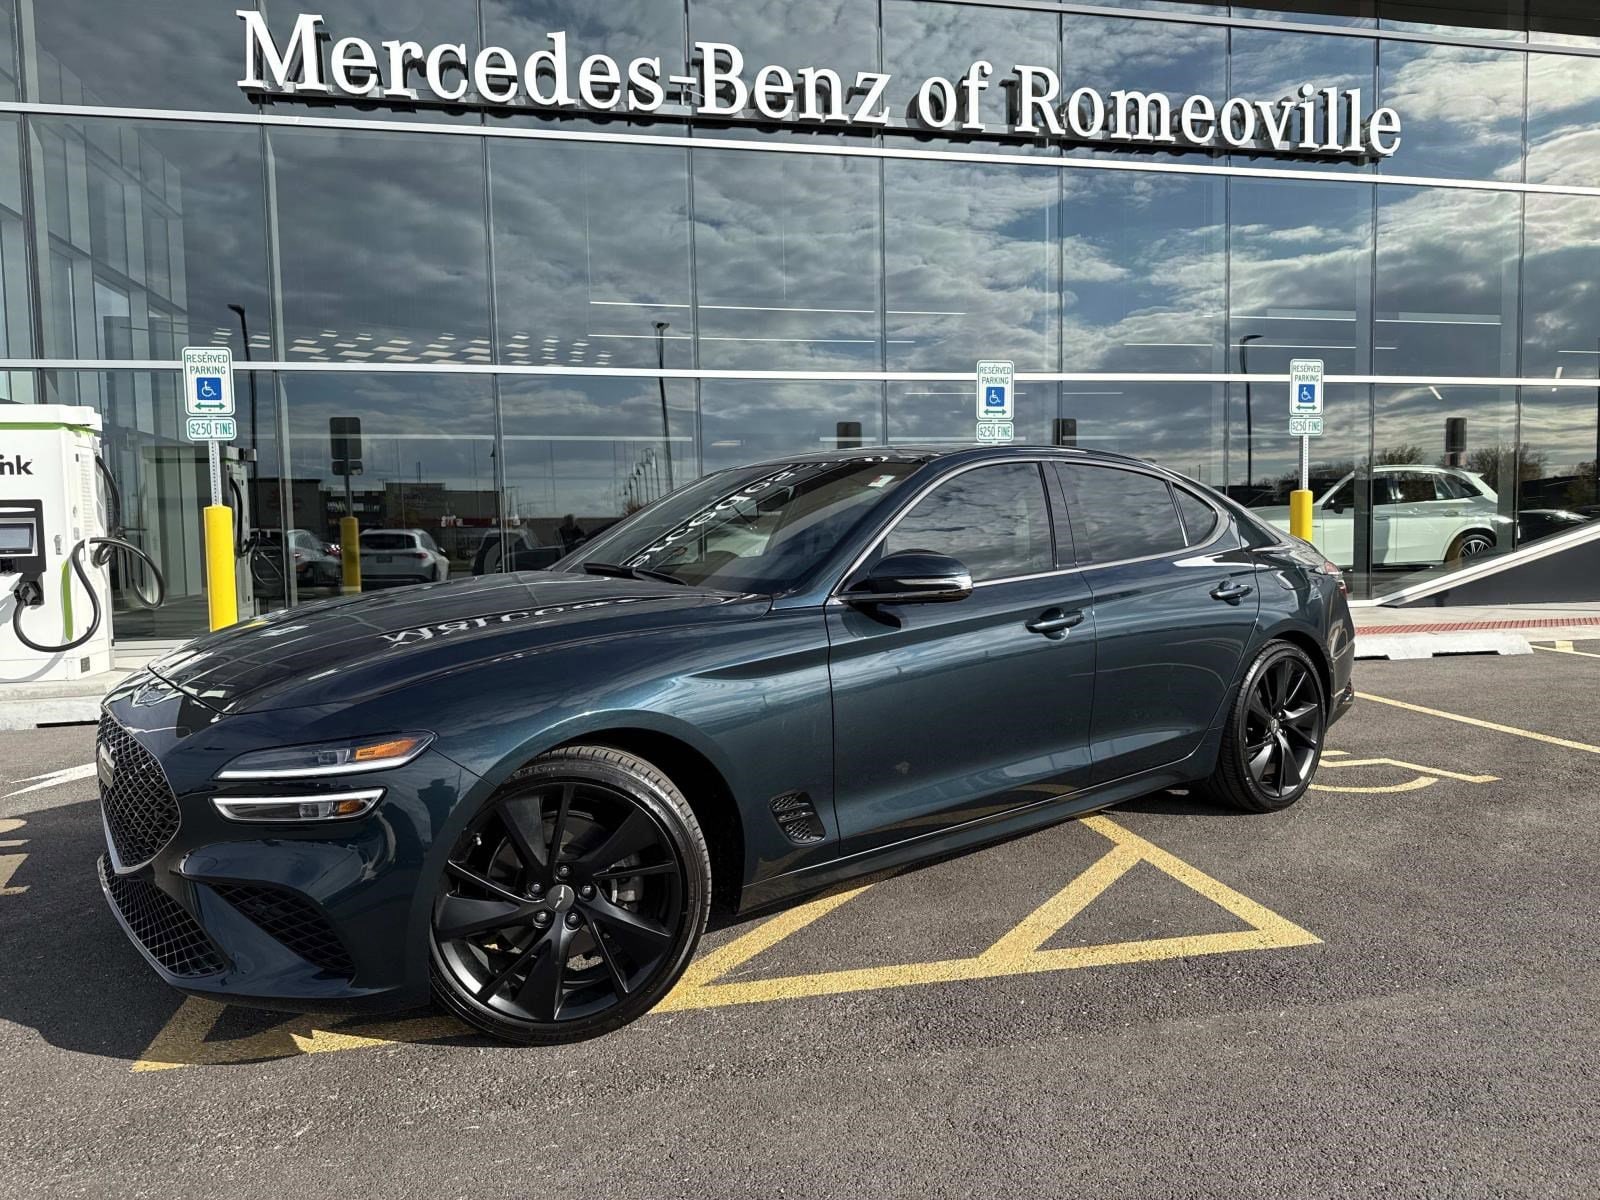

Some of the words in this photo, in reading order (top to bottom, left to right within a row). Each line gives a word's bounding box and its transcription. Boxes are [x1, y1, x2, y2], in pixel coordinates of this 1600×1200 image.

[236, 9, 892, 125] Mercedes-Benz
[918, 60, 994, 131] of
[1012, 64, 1402, 156] Romeoville
[186, 354, 228, 363] RESERVED
[189, 366, 226, 375] PARKING
[980, 366, 1011, 375] RESERVED
[1292, 365, 1321, 373] RESERVED
[981, 376, 1009, 385] PARKING
[1294, 374, 1319, 382] PARKING
[190, 422, 212, 435] $250
[215, 422, 232, 435] FINE
[1292, 420, 1306, 431] $250
[1308, 421, 1320, 431] FINE
[979, 426, 995, 438] $250
[997, 426, 1011, 438] FINE
